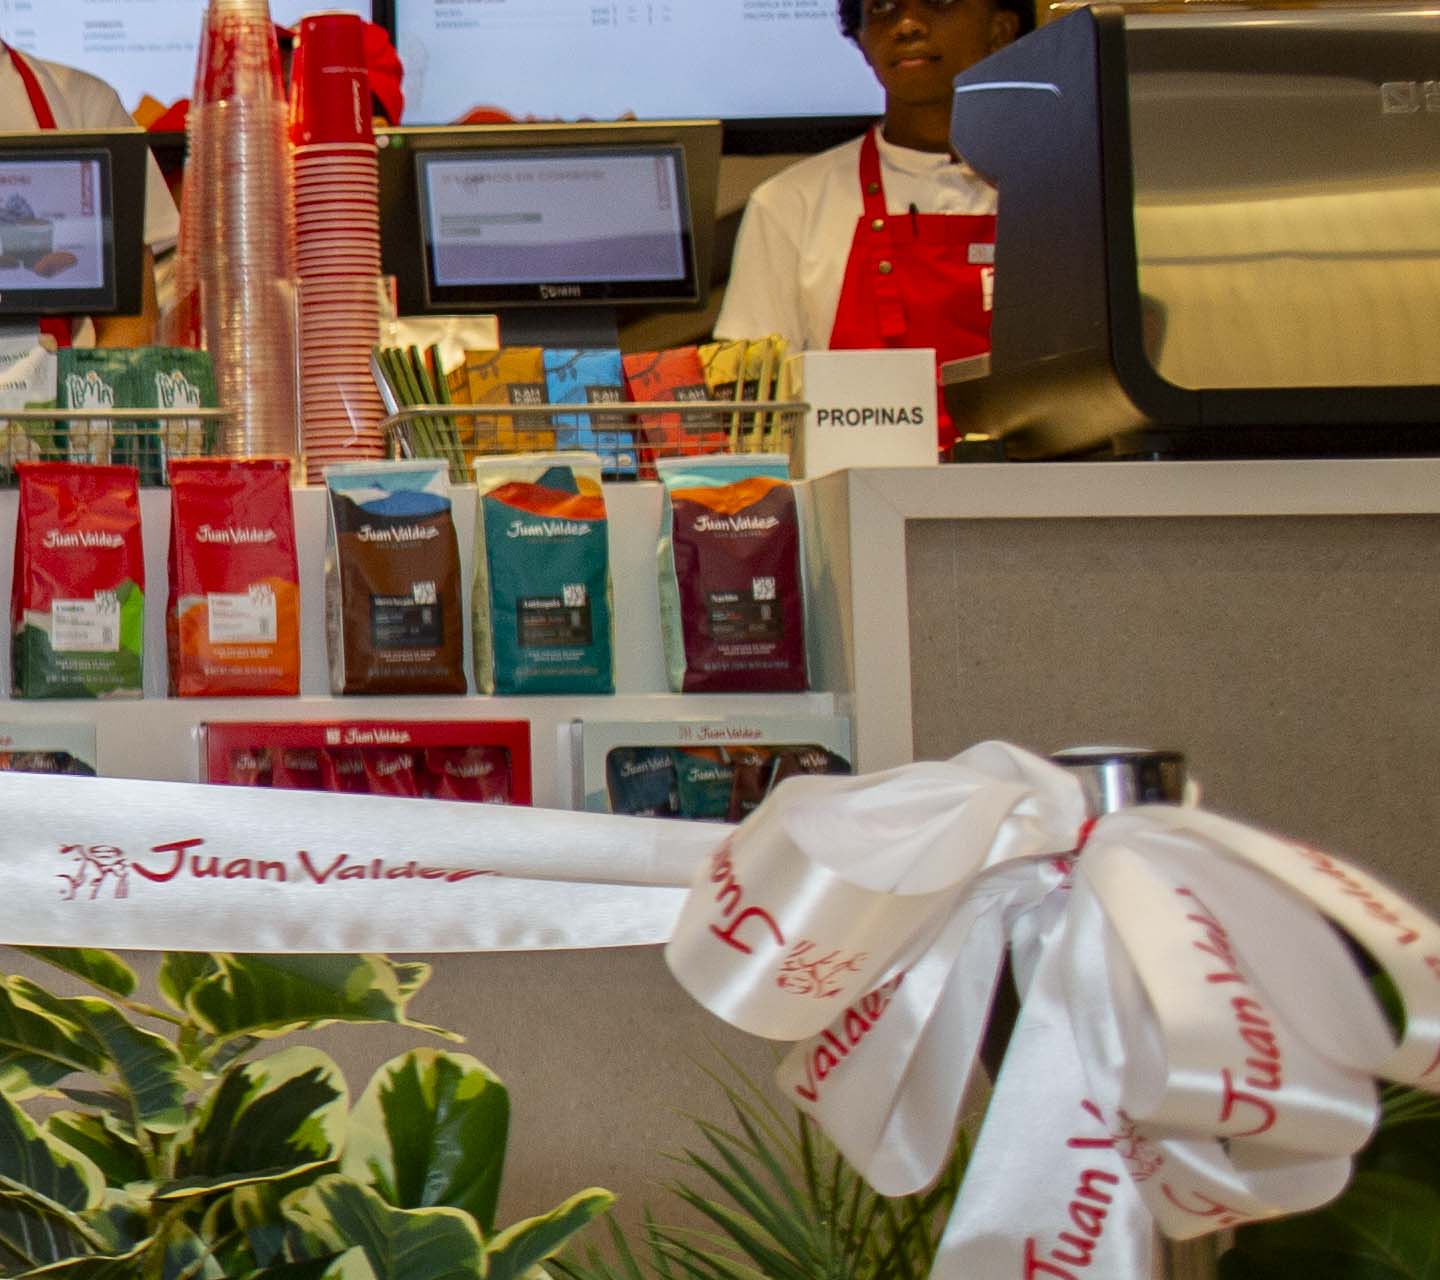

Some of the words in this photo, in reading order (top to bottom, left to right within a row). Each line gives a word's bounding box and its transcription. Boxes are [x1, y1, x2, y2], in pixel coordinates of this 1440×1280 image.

[817, 407, 924, 427] PROPINAS
[358, 524, 391, 542] Juan
[391, 524, 440, 543] Valdez
[507, 520, 543, 538] Juan
[543, 520, 592, 538] Valdez
[692, 515, 730, 532] Juan
[730, 515, 780, 532] Valdez
[42, 529, 79, 549] Juan
[79, 530, 126, 549] Valdez
[196, 524, 230, 544] Juan
[229, 526, 278, 544] Valdez
[130, 837, 288, 883] Juan
[1220, 996, 1282, 1138] Juan
